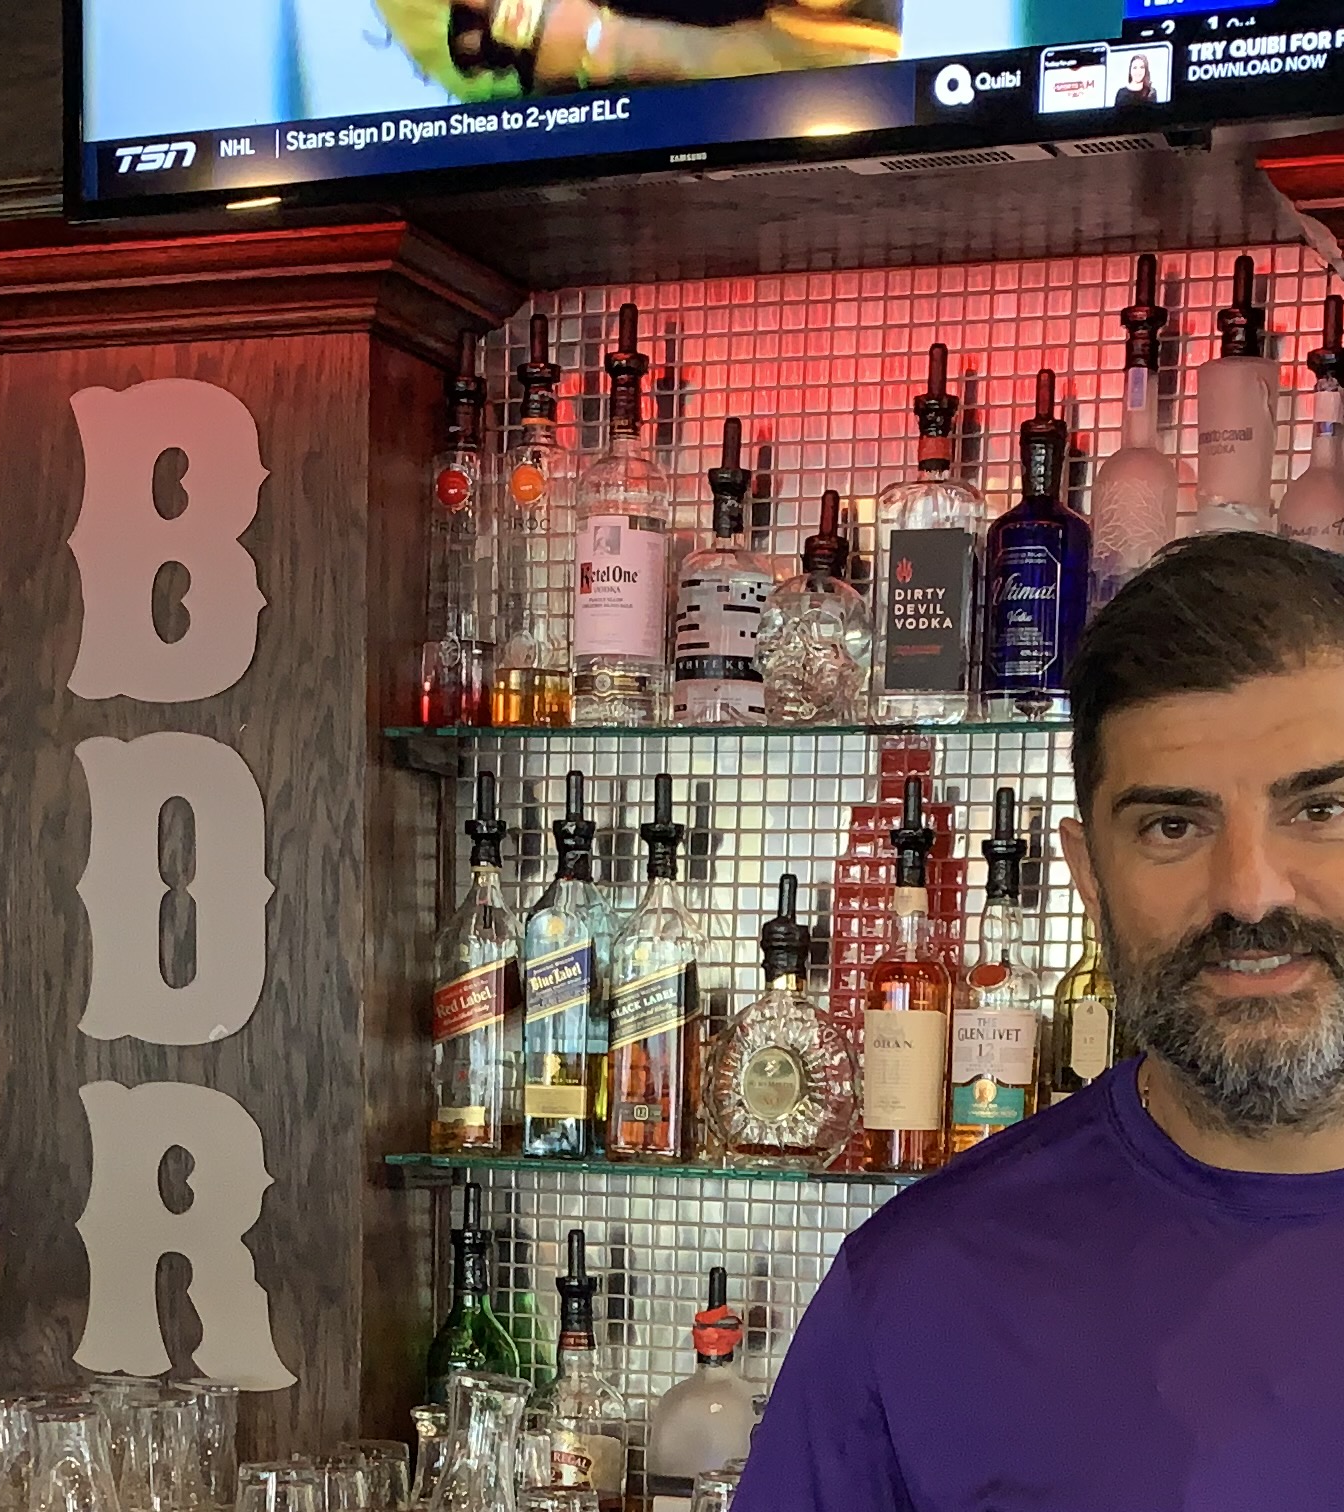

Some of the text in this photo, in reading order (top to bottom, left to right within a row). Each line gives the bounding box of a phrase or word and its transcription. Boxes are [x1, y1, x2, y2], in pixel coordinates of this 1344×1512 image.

[1188, 41, 1229, 62] TRY
[1229, 36, 1286, 58] QUIBI
[1290, 30, 1332, 52] FOR
[1188, 53, 1328, 82] DOWNLOAD NOW
[975, 70, 1021, 92] Quibi
[219, 98, 631, 157] NHL Stars sign D Ryan Shea to 2-year ELC
[115, 141, 196, 174] TSN
[580, 563, 638, 591] Ketel One
[895, 587, 946, 601] DIRTY
[894, 603, 944, 615] DEVIL
[894, 617, 953, 630] VODKA
[678, 659, 717, 671] WHITE
[530, 961, 582, 994] Blue Label
[643, 987, 677, 1007] LABEL
[435, 998, 459, 1018] Red
[976, 1017, 997, 1027] THE
[873, 1039, 914, 1049] OBAN
[957, 1027, 1022, 1043] GLENLIVET
[553, 1451, 587, 1468] REGAL
